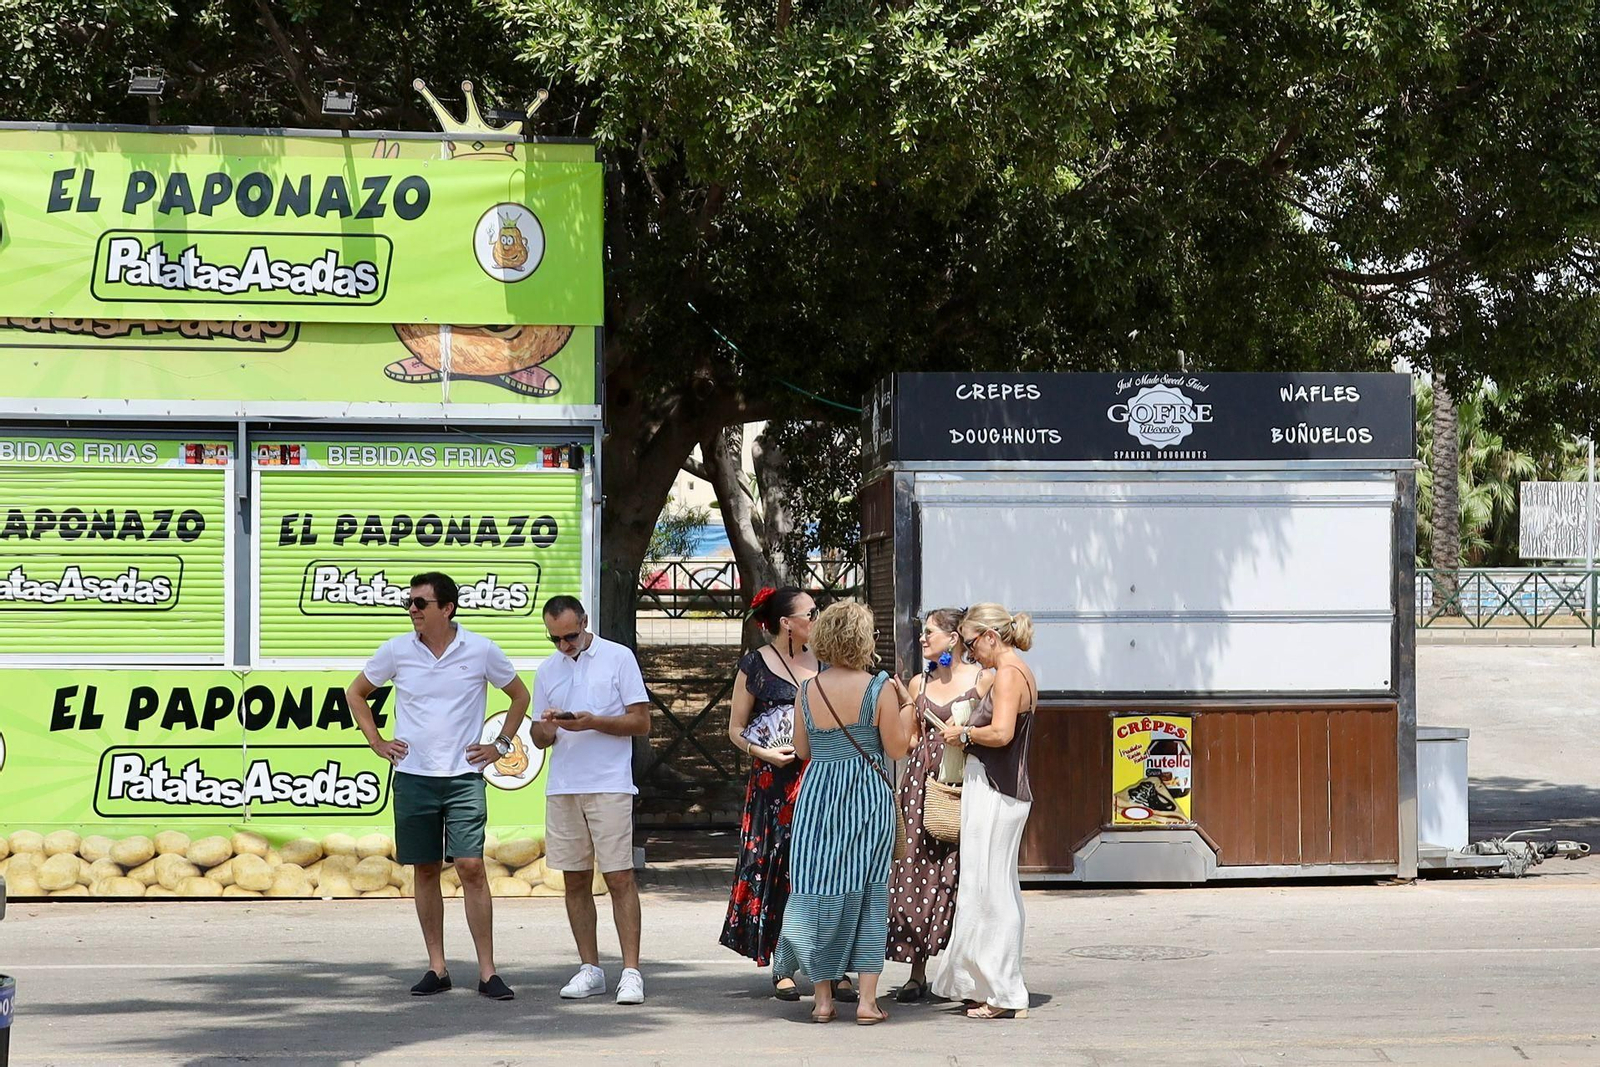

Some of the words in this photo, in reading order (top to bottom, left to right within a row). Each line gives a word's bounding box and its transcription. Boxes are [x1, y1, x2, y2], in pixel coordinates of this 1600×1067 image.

[47, 168, 102, 213] EL
[122, 171, 431, 220] PAPONAZO
[955, 382, 1041, 400] CREPES
[1280, 383, 1361, 402] WAFLES
[1106, 403, 1214, 424] GOFRE
[949, 427, 1062, 445] DOUGHNUTS
[1270, 422, 1373, 444] BUÑUELOS
[83, 442, 158, 464] FRIAS
[327, 445, 437, 467] BEBIDAS
[444, 447, 516, 469] FRIAS
[1114, 450, 1151, 460] SPANISH
[1157, 450, 1207, 460] DOUGHNUTS
[278, 512, 317, 547] EL
[333, 514, 559, 549] PAPONAZO
[49, 684, 104, 732] EL
[124, 685, 397, 732] PAPONAZ
[1117, 717, 1187, 738] CRÊPES
[1146, 753, 1190, 768] nutella
